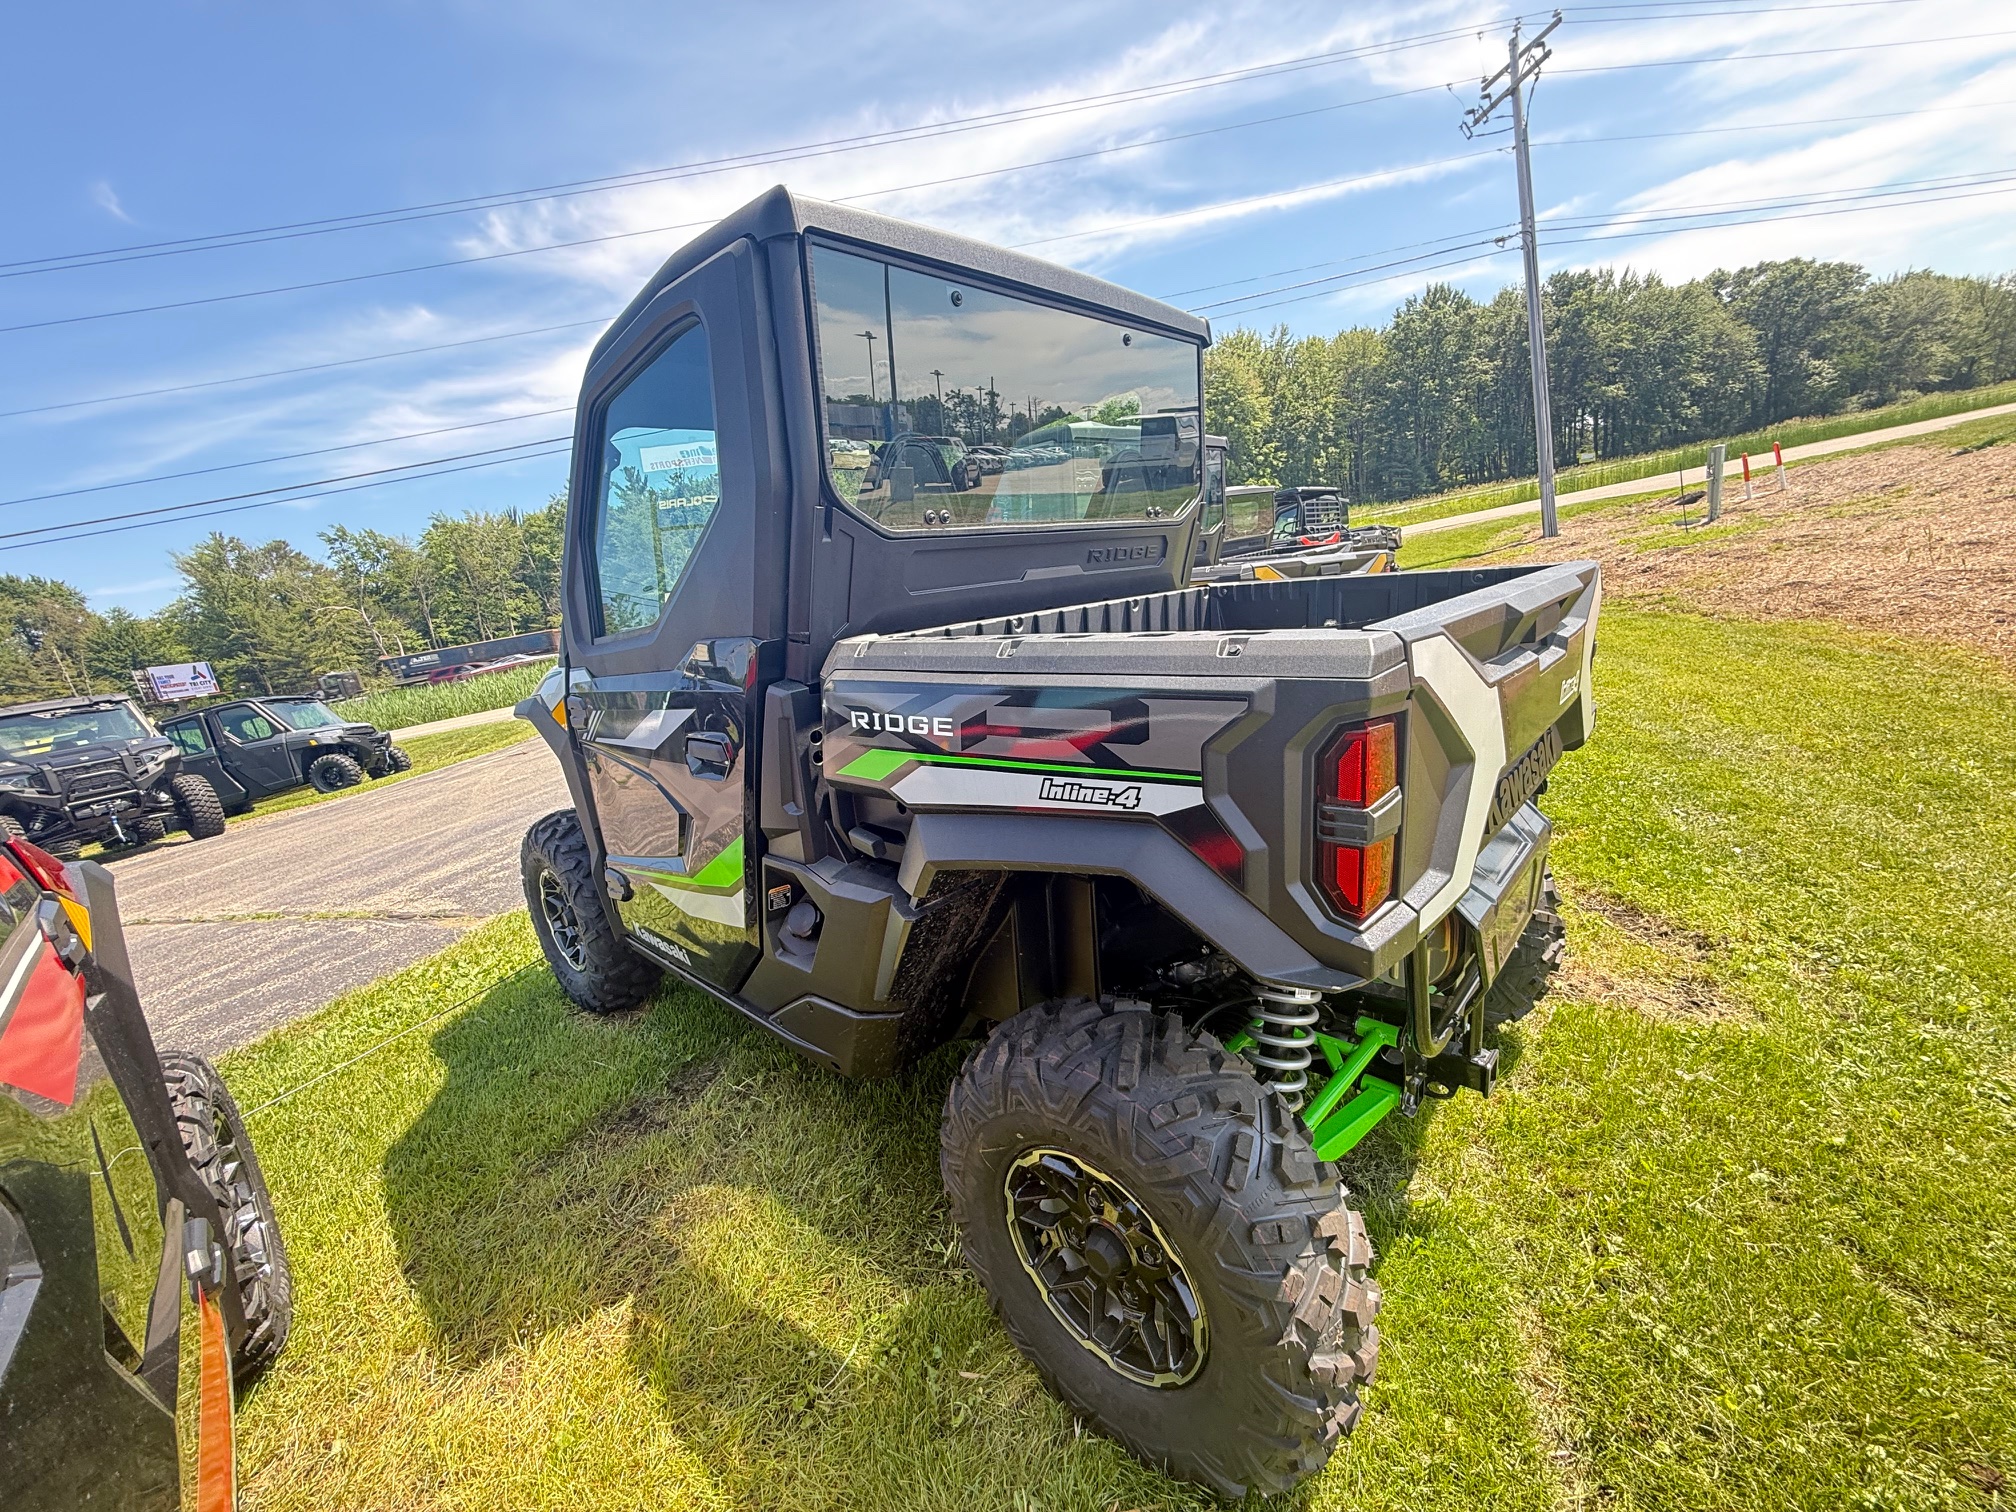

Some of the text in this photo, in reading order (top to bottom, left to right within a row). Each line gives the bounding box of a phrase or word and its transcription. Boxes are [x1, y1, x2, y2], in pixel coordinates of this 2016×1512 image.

[1086, 544, 1158, 564] RIDGE
[850, 710, 954, 738] RIDGE
[1039, 777, 1142, 810] Inline-4
[631, 920, 692, 967] Kawasaki
